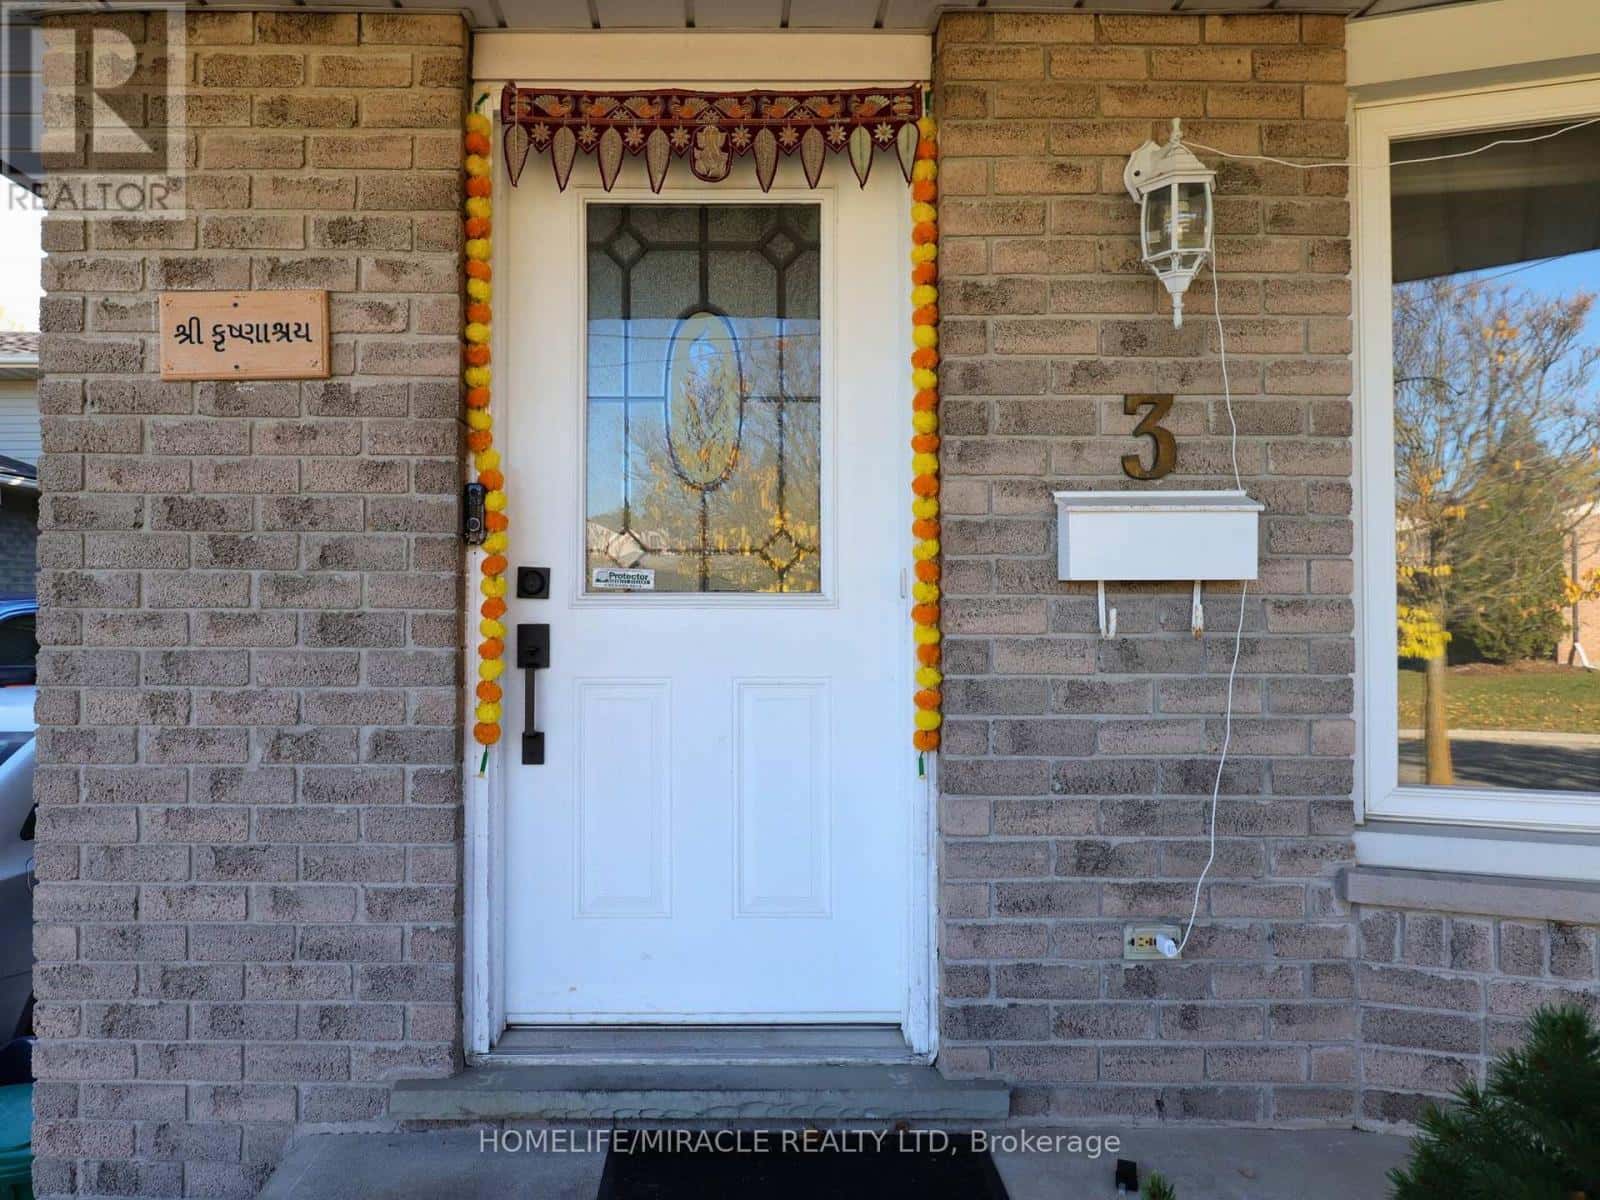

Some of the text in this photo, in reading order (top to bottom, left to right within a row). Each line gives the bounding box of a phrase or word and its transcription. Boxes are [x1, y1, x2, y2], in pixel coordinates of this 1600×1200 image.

[174, 316, 204, 345] શ્રી
[1121, 393, 1178, 480] 3
[608, 571, 649, 581] Protector
